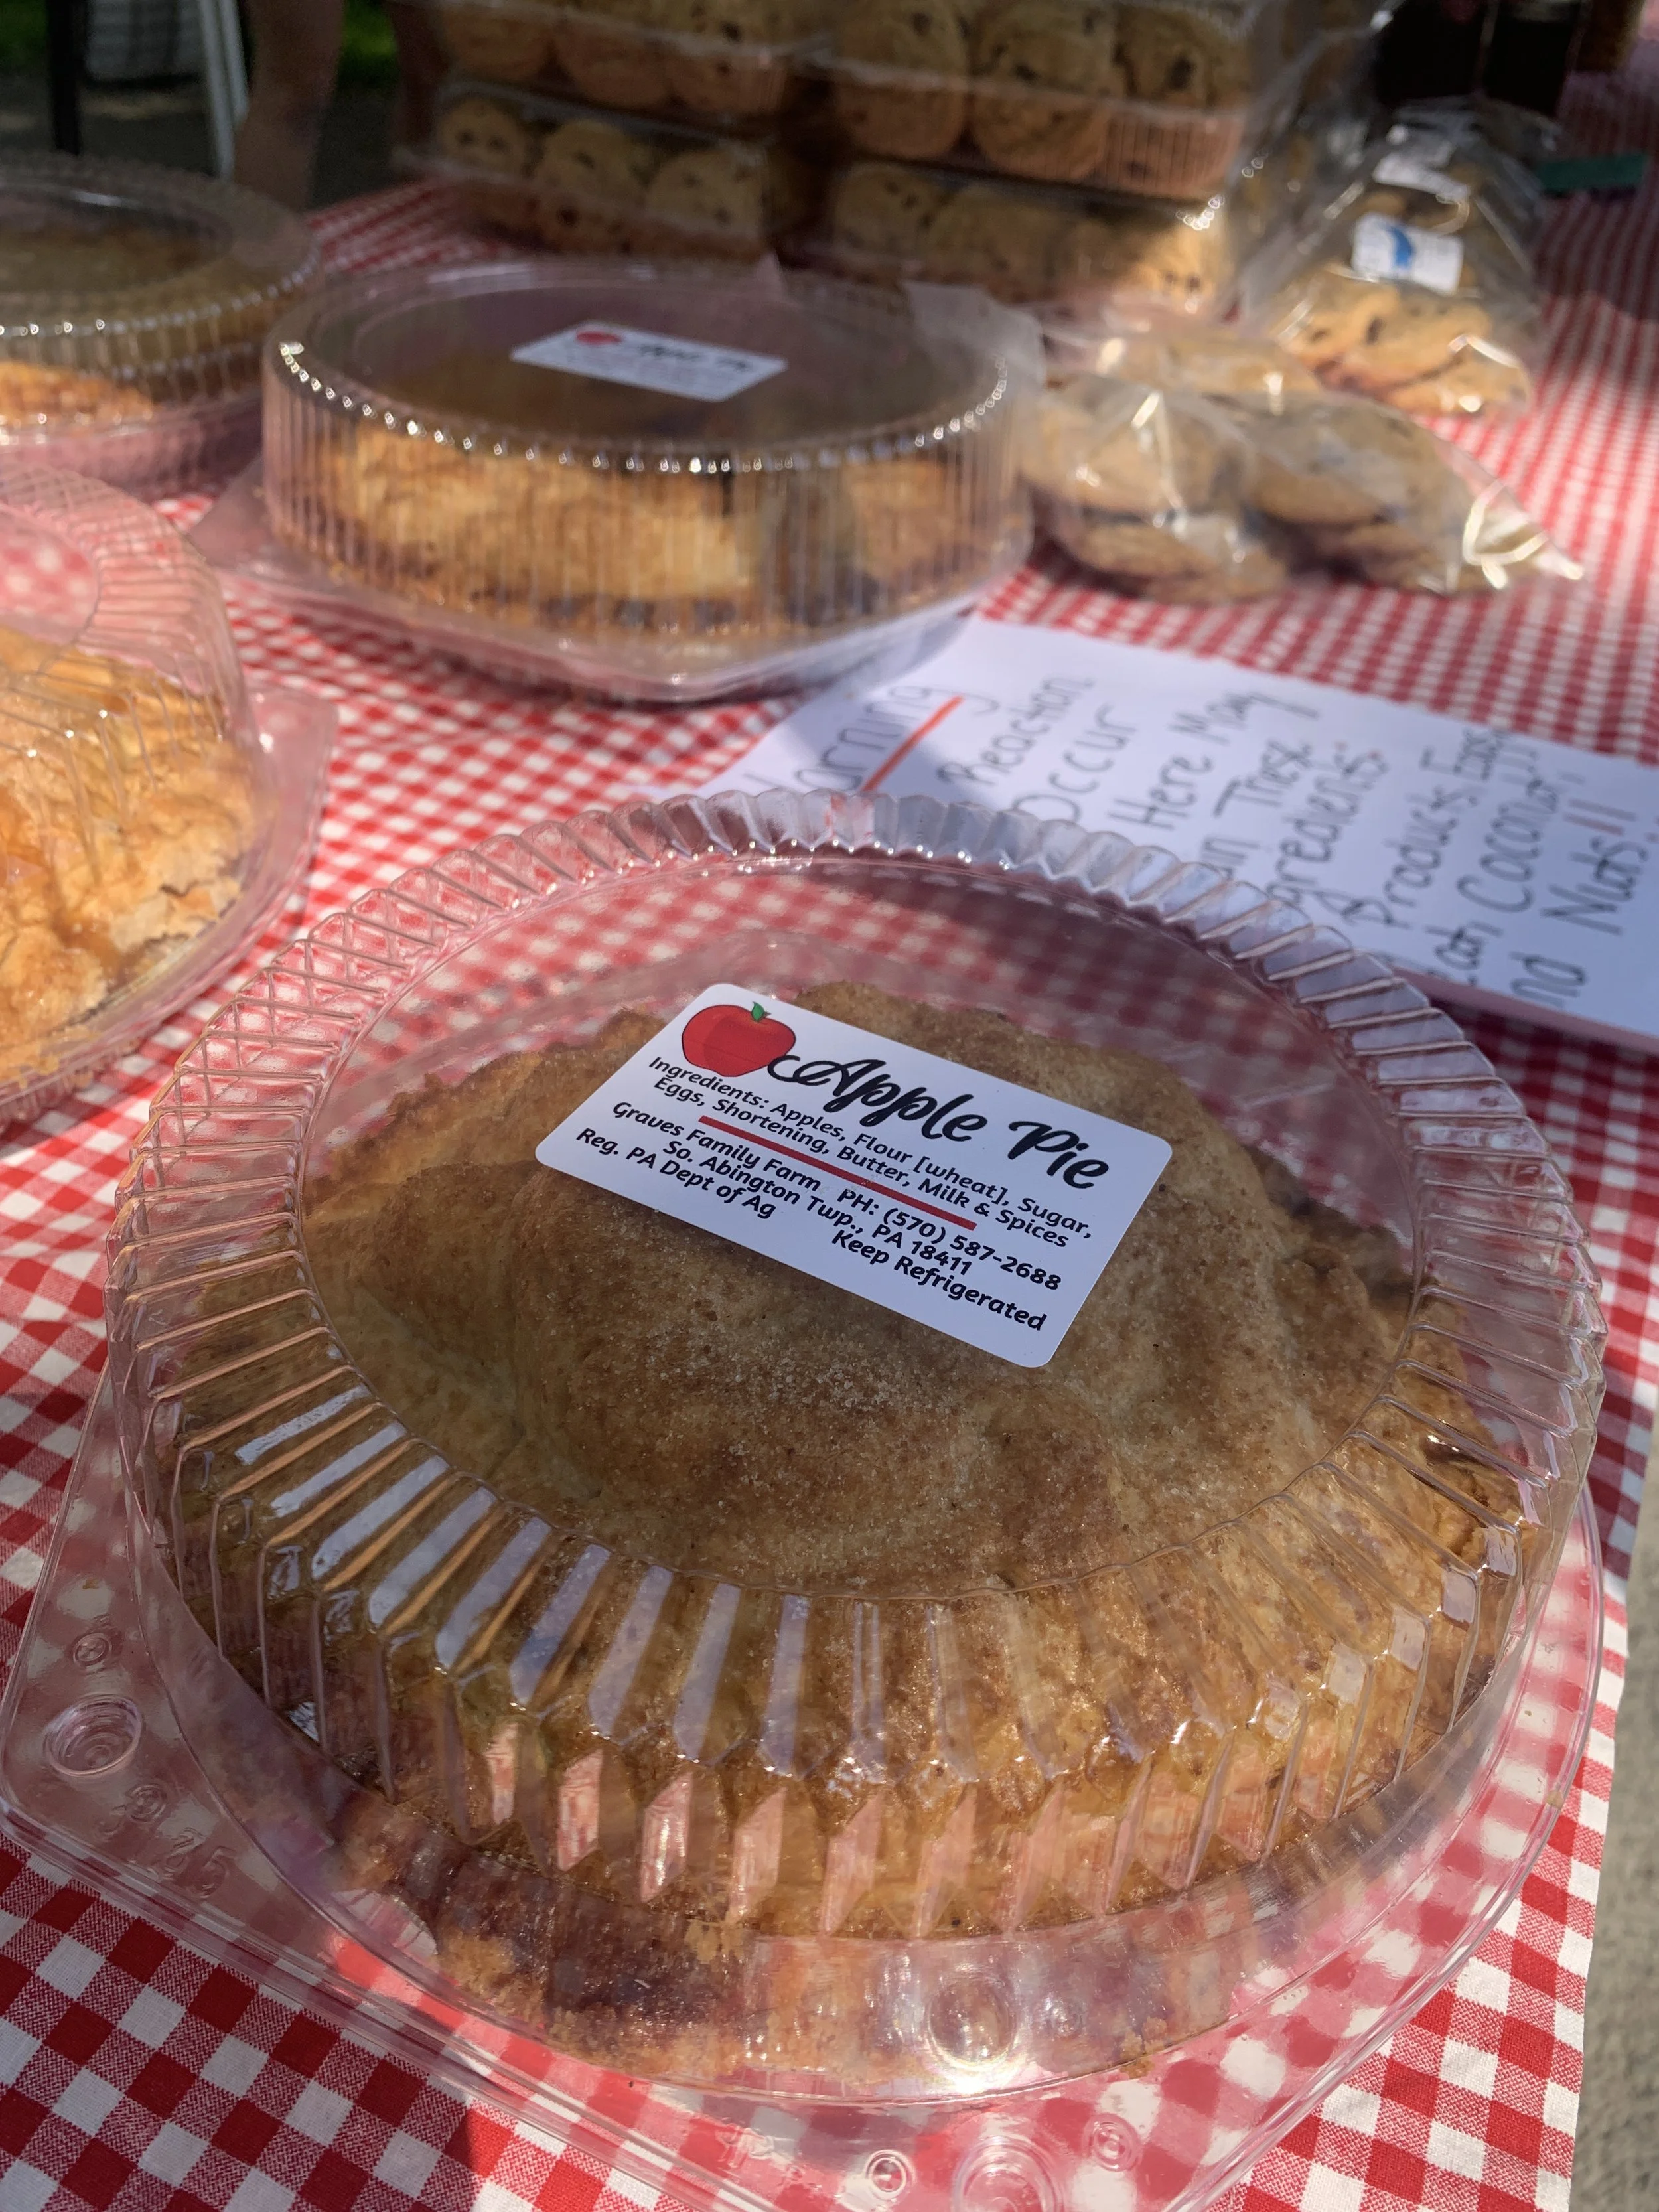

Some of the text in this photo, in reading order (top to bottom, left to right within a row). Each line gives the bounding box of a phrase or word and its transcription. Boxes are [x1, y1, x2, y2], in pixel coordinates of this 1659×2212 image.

[742, 684, 999, 792] arning
[1010, 705, 1136, 822] Occur
[1107, 691, 1319, 830] Here May
[576, 1128, 776, 1219] Reg. PA Dept of Ag
[649, 1057, 1092, 1239] Ingredients: Apples, Flour [wheat], Sugar,
[654, 1078, 1069, 1248] Eggs, Shortening, Butter, Milk & Spices
[767, 1055, 1109, 1189] Apple Pie
[613, 1102, 1062, 1290] Graves Family Farm PH: (570) 587-2688
[663, 1140, 972, 1276] So. Abington Twp., PA 18411
[831, 1229, 1047, 1331] Keep Refrigerated
